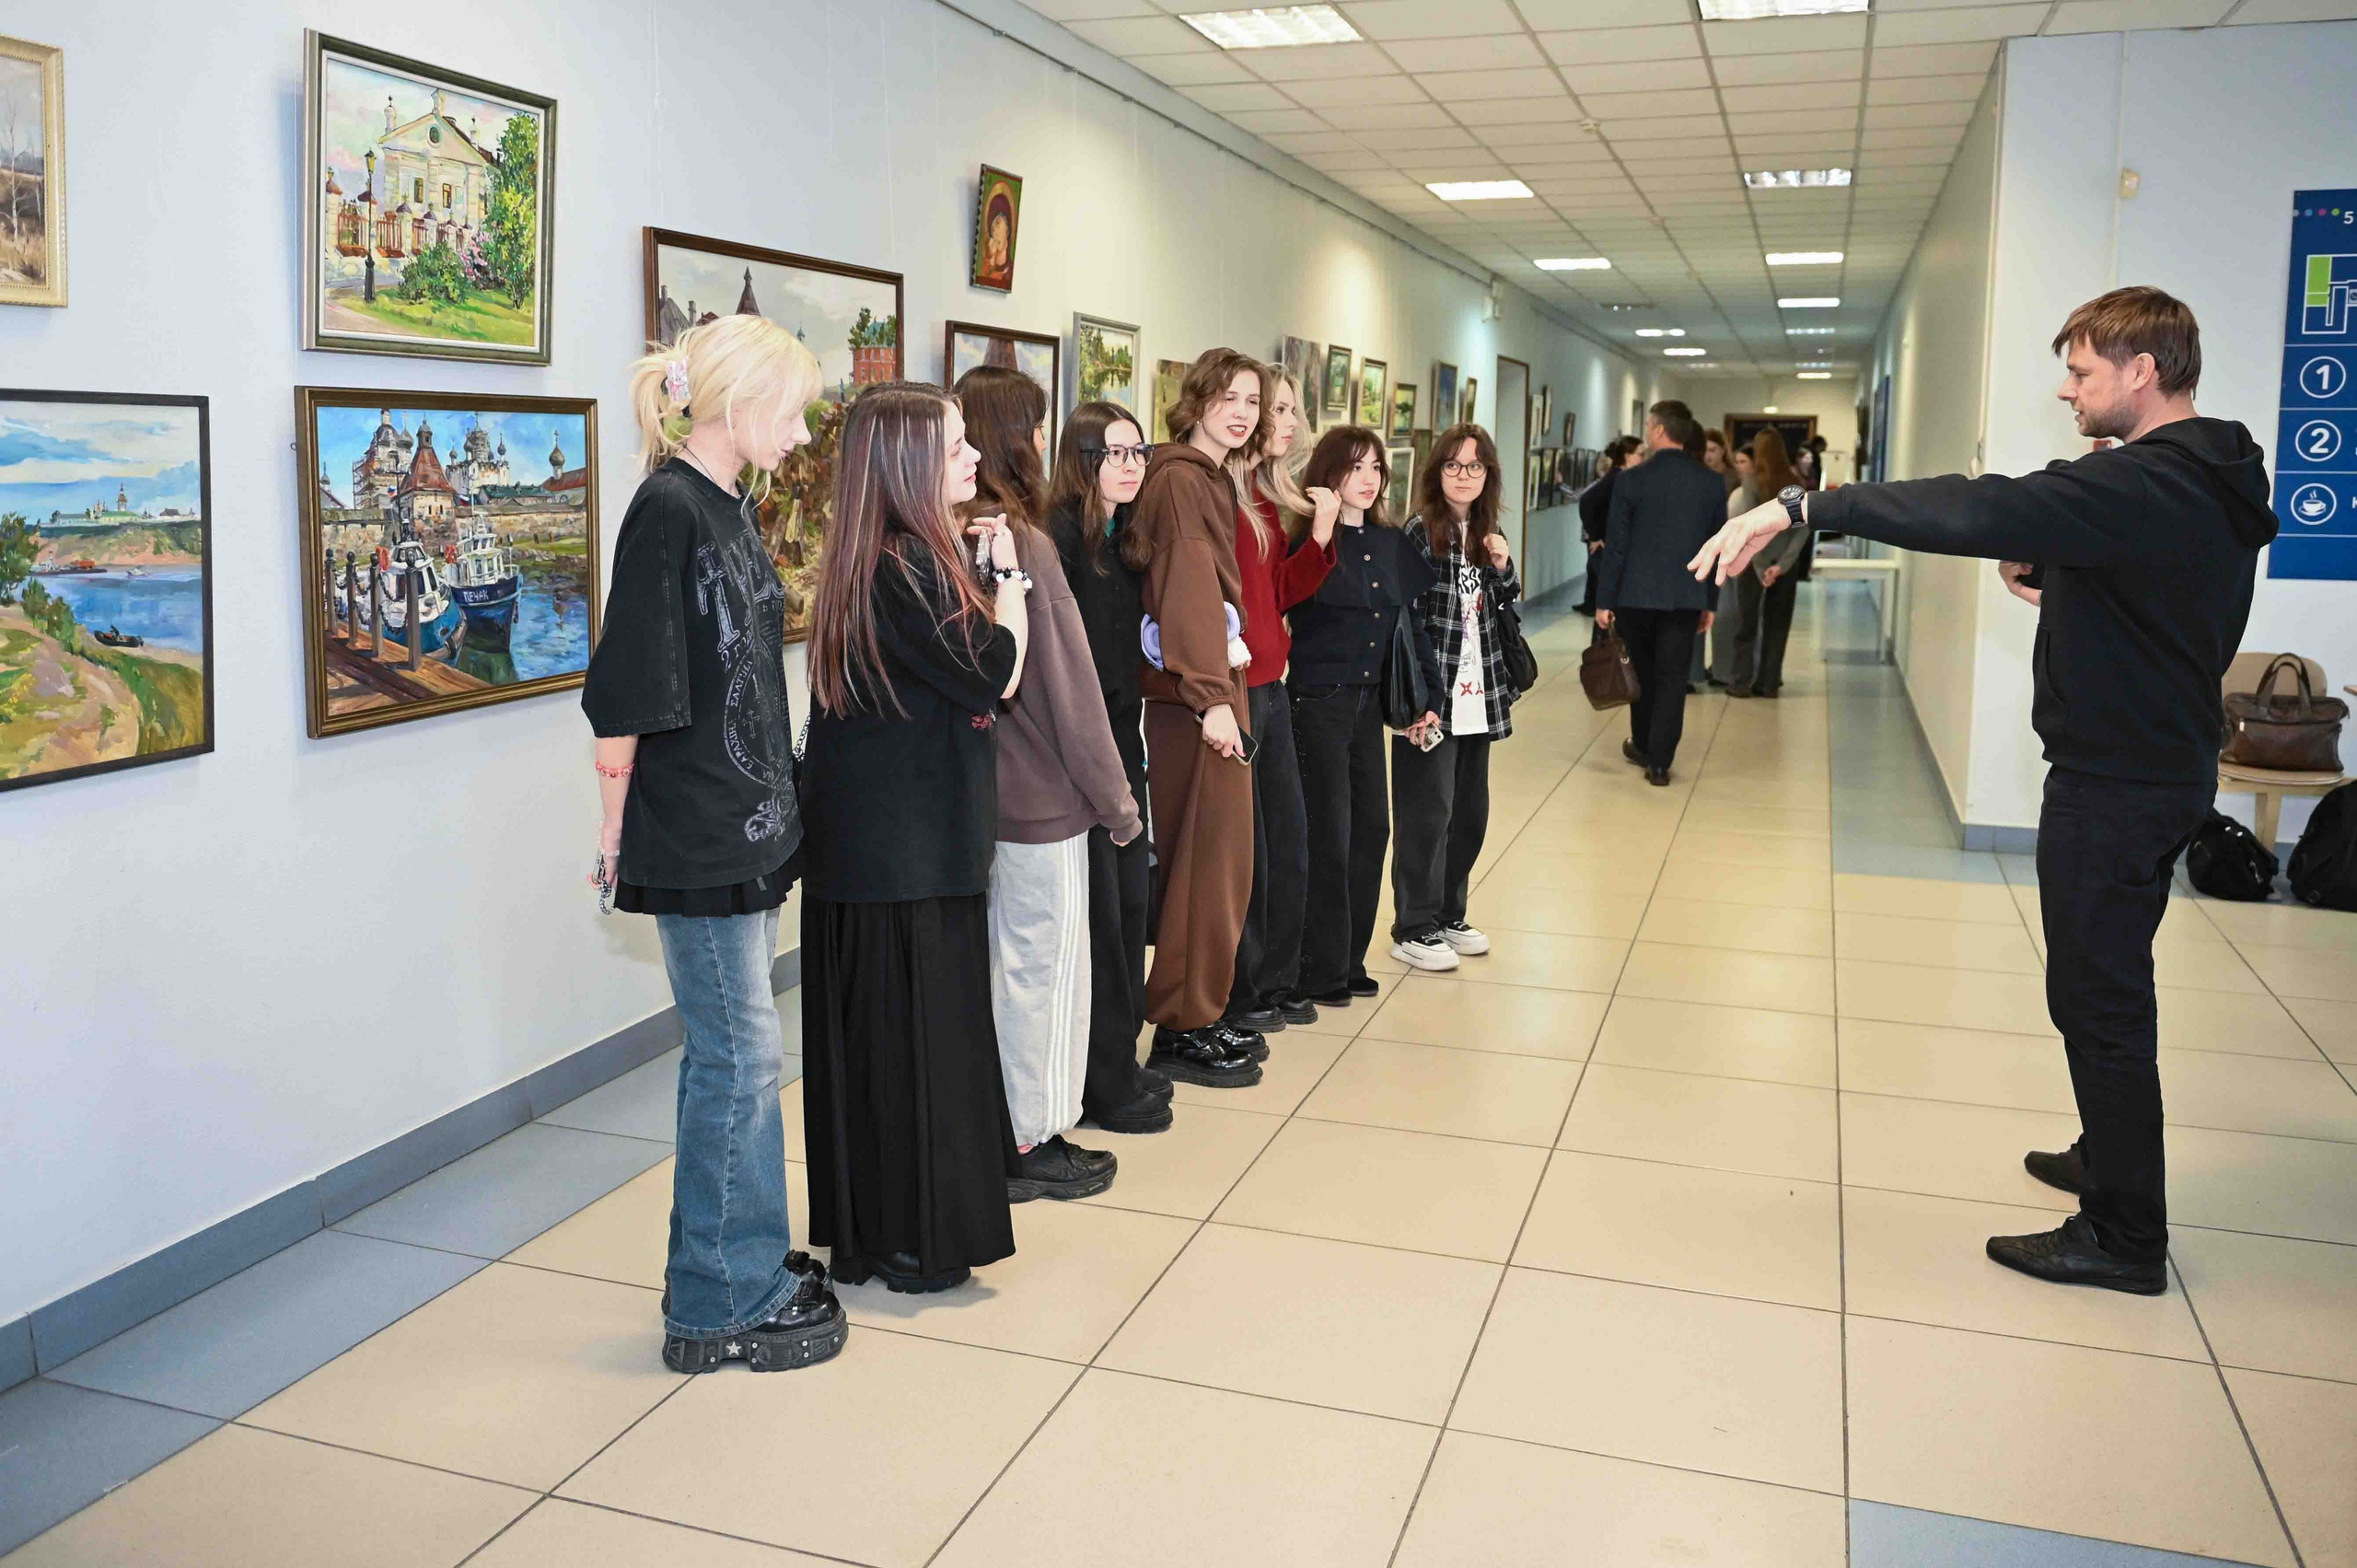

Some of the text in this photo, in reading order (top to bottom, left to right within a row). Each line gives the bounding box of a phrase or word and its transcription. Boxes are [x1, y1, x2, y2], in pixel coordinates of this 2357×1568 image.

[2343, 211, 2354, 225] 5
[2316, 365, 2330, 390] 1
[2309, 427, 2329, 454] 2
